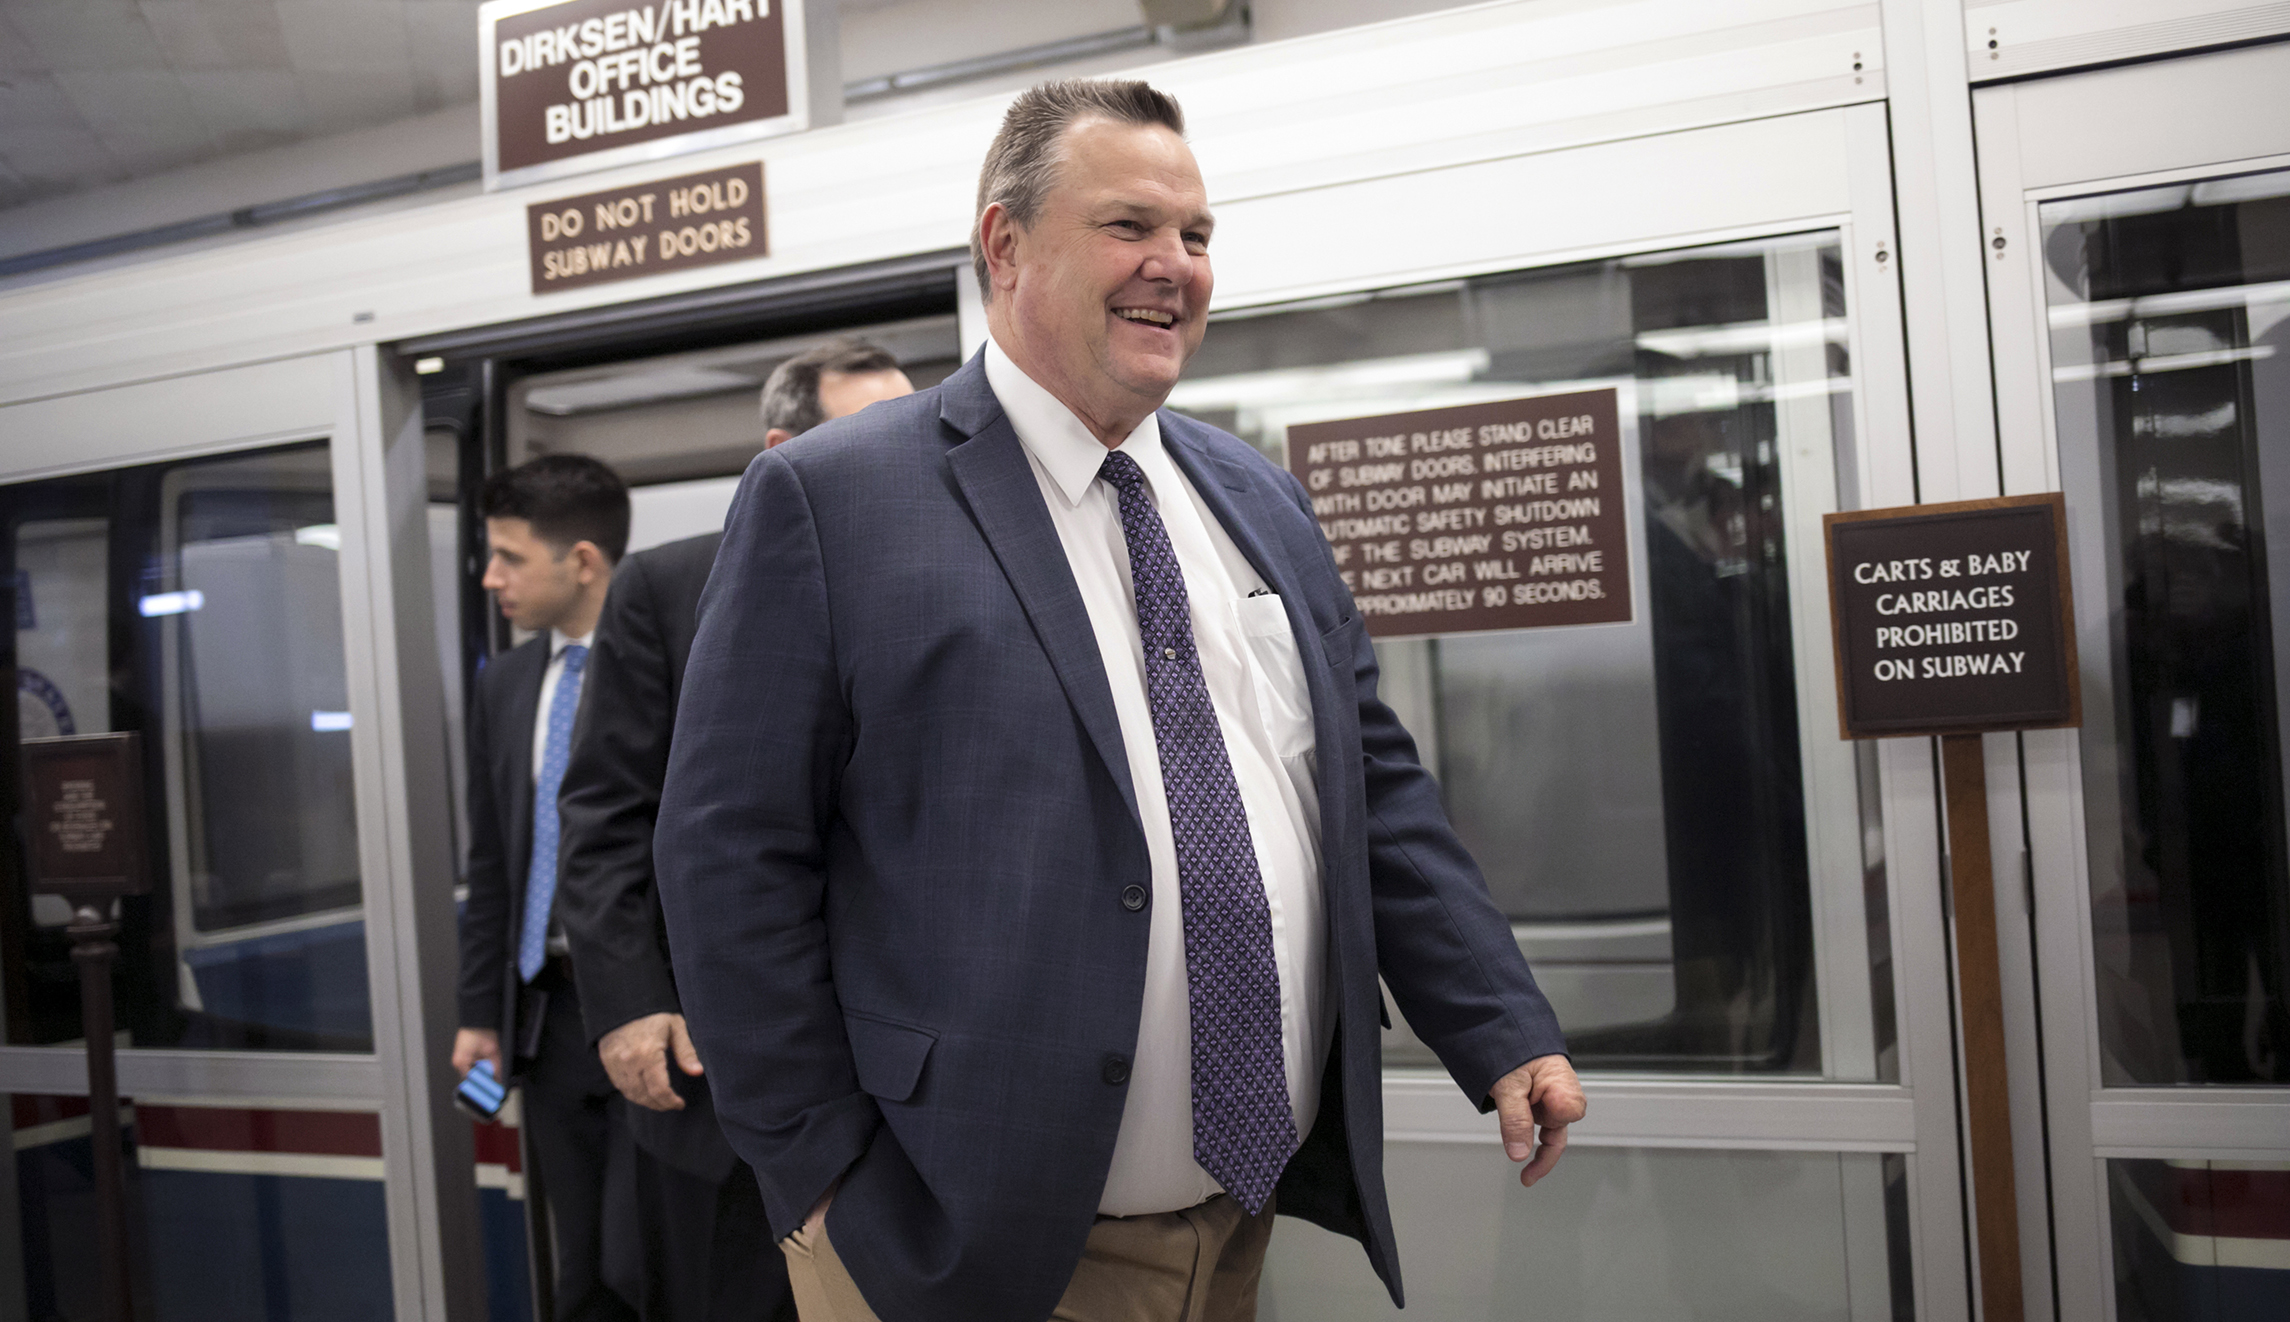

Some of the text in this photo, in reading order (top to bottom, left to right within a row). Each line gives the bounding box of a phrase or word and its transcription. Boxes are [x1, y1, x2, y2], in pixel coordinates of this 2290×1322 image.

[568, 36, 702, 100] OFFICE
[545, 71, 744, 144] BUILDINGS
[541, 178, 748, 241] DO NOT HOLD
[543, 217, 751, 280] SUBWAY DOORS
[1308, 414, 1594, 464] AFTER TONE PLEASE STAND CLEAR
[1308, 442, 1597, 491] OF SUBWAY DOORS. INTERFERING
[1311, 470, 1598, 516] WITH DOOR MAY INITIATE AN
[1320, 497, 1600, 541] UTOMATIC SAFETY SHUTDOWN
[1361, 540, 1401, 563] THE
[1409, 534, 1492, 560] SUBWAY
[1502, 525, 1592, 551] SYSTEM.
[1362, 565, 1414, 590] NEXT
[1423, 561, 1465, 586] CAR
[1473, 559, 1520, 581] WILL
[1529, 550, 1603, 577] ARRIVE
[1854, 550, 2031, 584] CARTS & BABY
[1353, 579, 1605, 615] PPROXIMATELY 90 SECONDS.
[1876, 585, 2014, 615] CARRIAGES
[1876, 619, 2018, 648] PROHIBITED
[1874, 651, 2025, 681] ON SUBWAY
